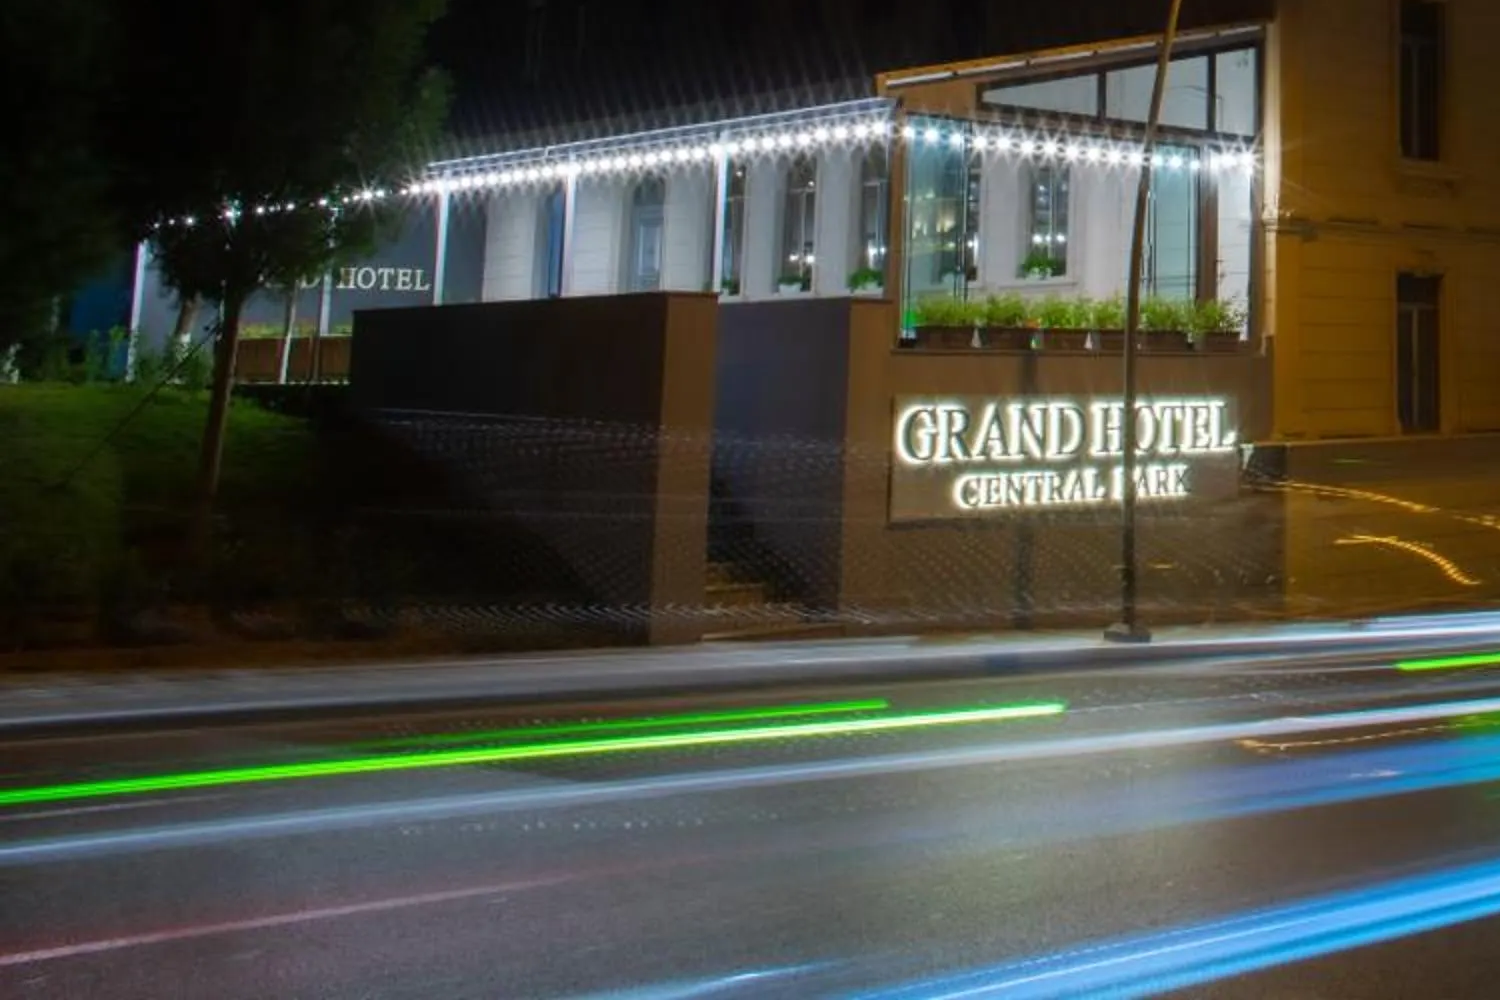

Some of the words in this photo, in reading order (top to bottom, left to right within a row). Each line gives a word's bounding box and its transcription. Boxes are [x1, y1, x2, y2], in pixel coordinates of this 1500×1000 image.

[336, 266, 432, 292] HOTEL
[897, 401, 1086, 464] GRAND
[1090, 399, 1237, 456] HOTEL
[954, 466, 1105, 509] CENTRAL
[1111, 463, 1191, 501] ARK
